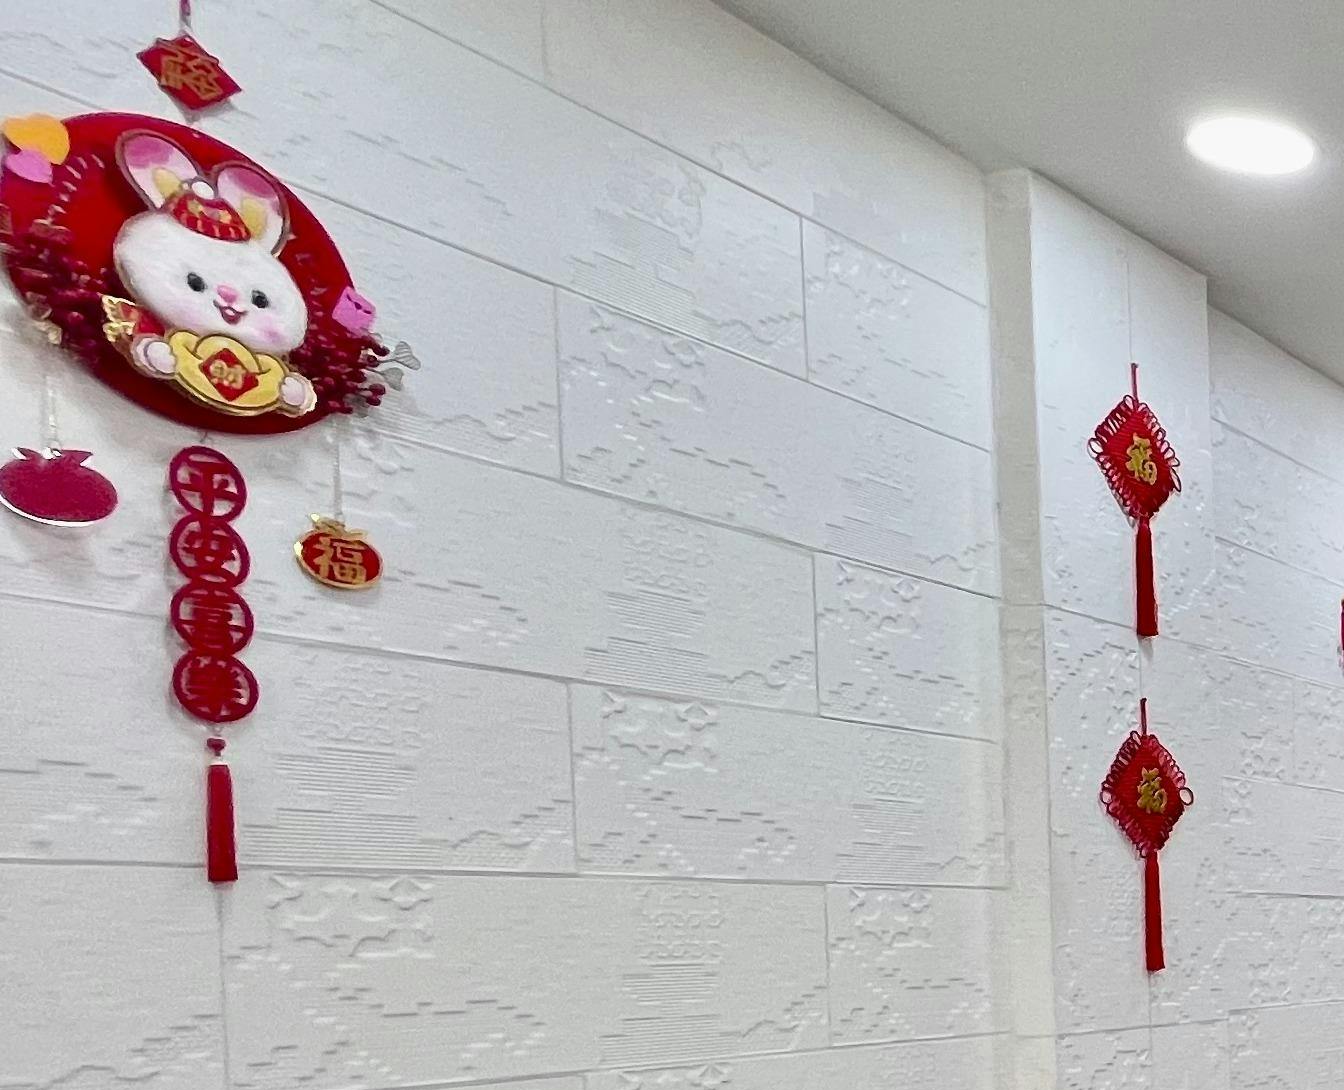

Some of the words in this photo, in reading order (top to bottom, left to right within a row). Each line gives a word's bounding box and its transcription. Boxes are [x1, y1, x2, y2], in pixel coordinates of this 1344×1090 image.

[1125, 432, 1158, 486] 福
[312, 535, 368, 586] 福
[1137, 766, 1168, 815] 福
